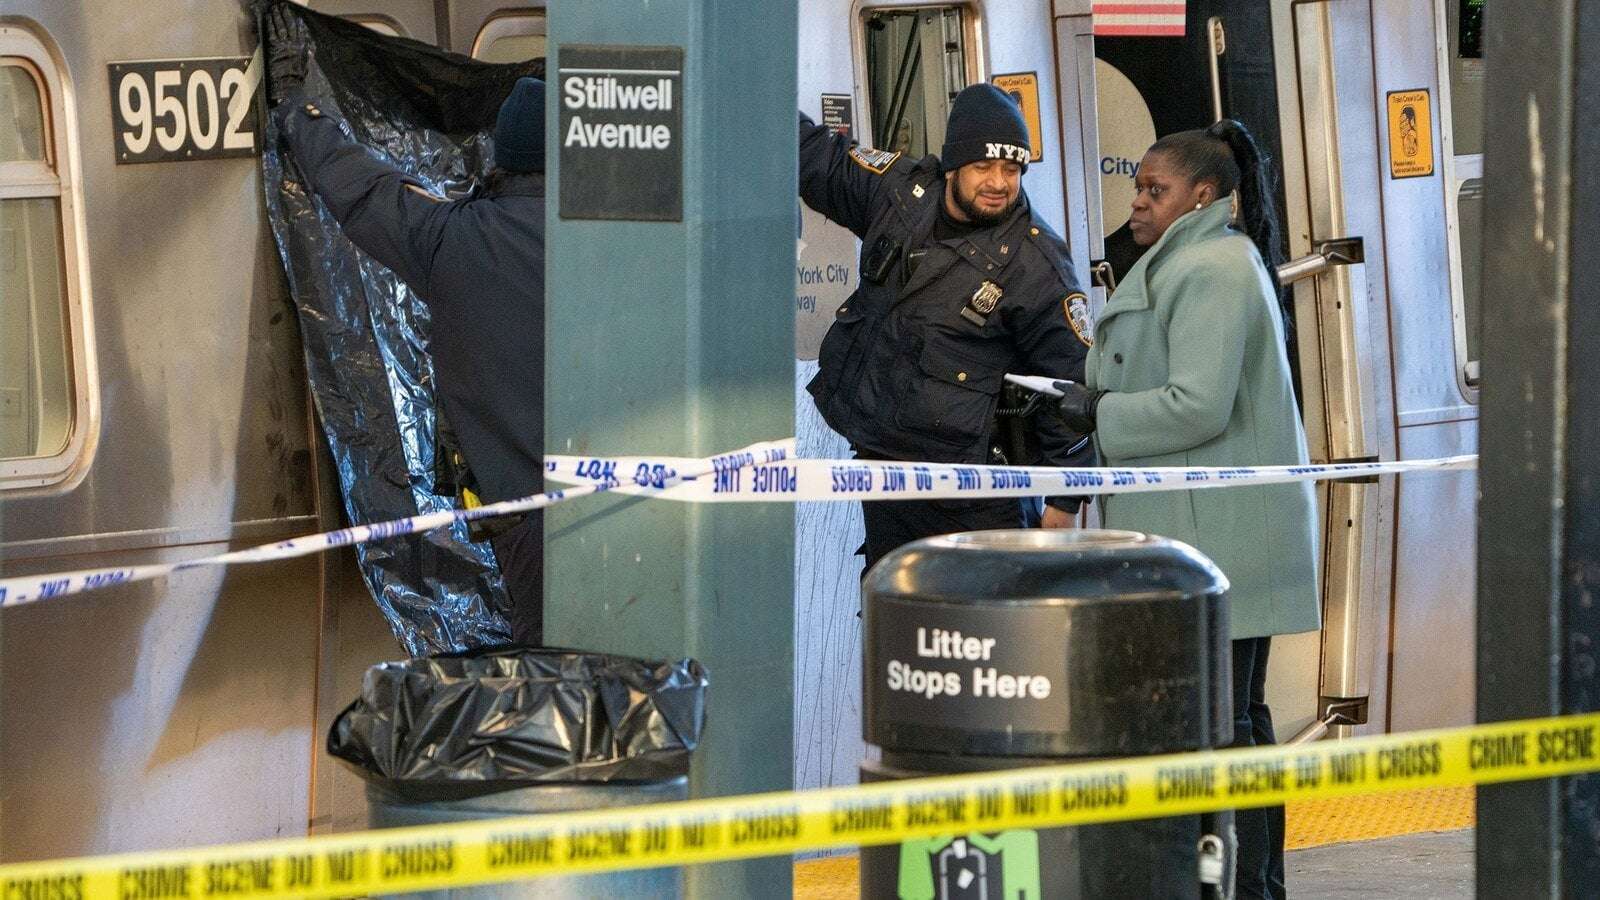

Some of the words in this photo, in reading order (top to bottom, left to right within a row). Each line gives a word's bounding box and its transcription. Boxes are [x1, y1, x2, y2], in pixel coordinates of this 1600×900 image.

[564, 76, 672, 111] Stillwell
[119, 68, 255, 154] 9502
[564, 115, 671, 149] Avenue
[1101, 156, 1140, 179] City
[797, 266, 823, 284] York
[826, 264, 849, 286] City
[713, 466, 741, 493] LINE
[753, 466, 797, 493] POLICE
[831, 466, 873, 492] CROSS
[882, 466, 907, 491] NOT
[913, 467, 933, 491] DO
[954, 467, 982, 490] LINE
[992, 468, 1032, 489] POLICE
[917, 627, 996, 661] Litter
[887, 659, 962, 699] Stops
[973, 667, 1051, 699] Here
[1469, 732, 1527, 769] CRIME
[1538, 724, 1594, 763] SCENE
[1157, 764, 1215, 801] CRIME
[1228, 756, 1285, 796] SCENE
[1296, 753, 1321, 788] DO
[1330, 749, 1367, 784] NOT
[1377, 740, 1441, 781] CROSS
[831, 796, 893, 833] CRIME
[906, 789, 966, 827] SCENE
[977, 785, 1003, 819] DO
[1013, 779, 1051, 815] NOT
[1061, 771, 1127, 810] CROSS
[488, 828, 554, 868] CRIME
[567, 821, 630, 860] SCENE
[643, 816, 669, 852] DO
[680, 811, 721, 848] NOT
[732, 805, 800, 844] CROSS
[119, 864, 191, 900] CRIME
[204, 857, 274, 896] SCENE
[286, 853, 314, 887] DO
[328, 847, 370, 882] NOT
[381, 840, 454, 878] CROSS
